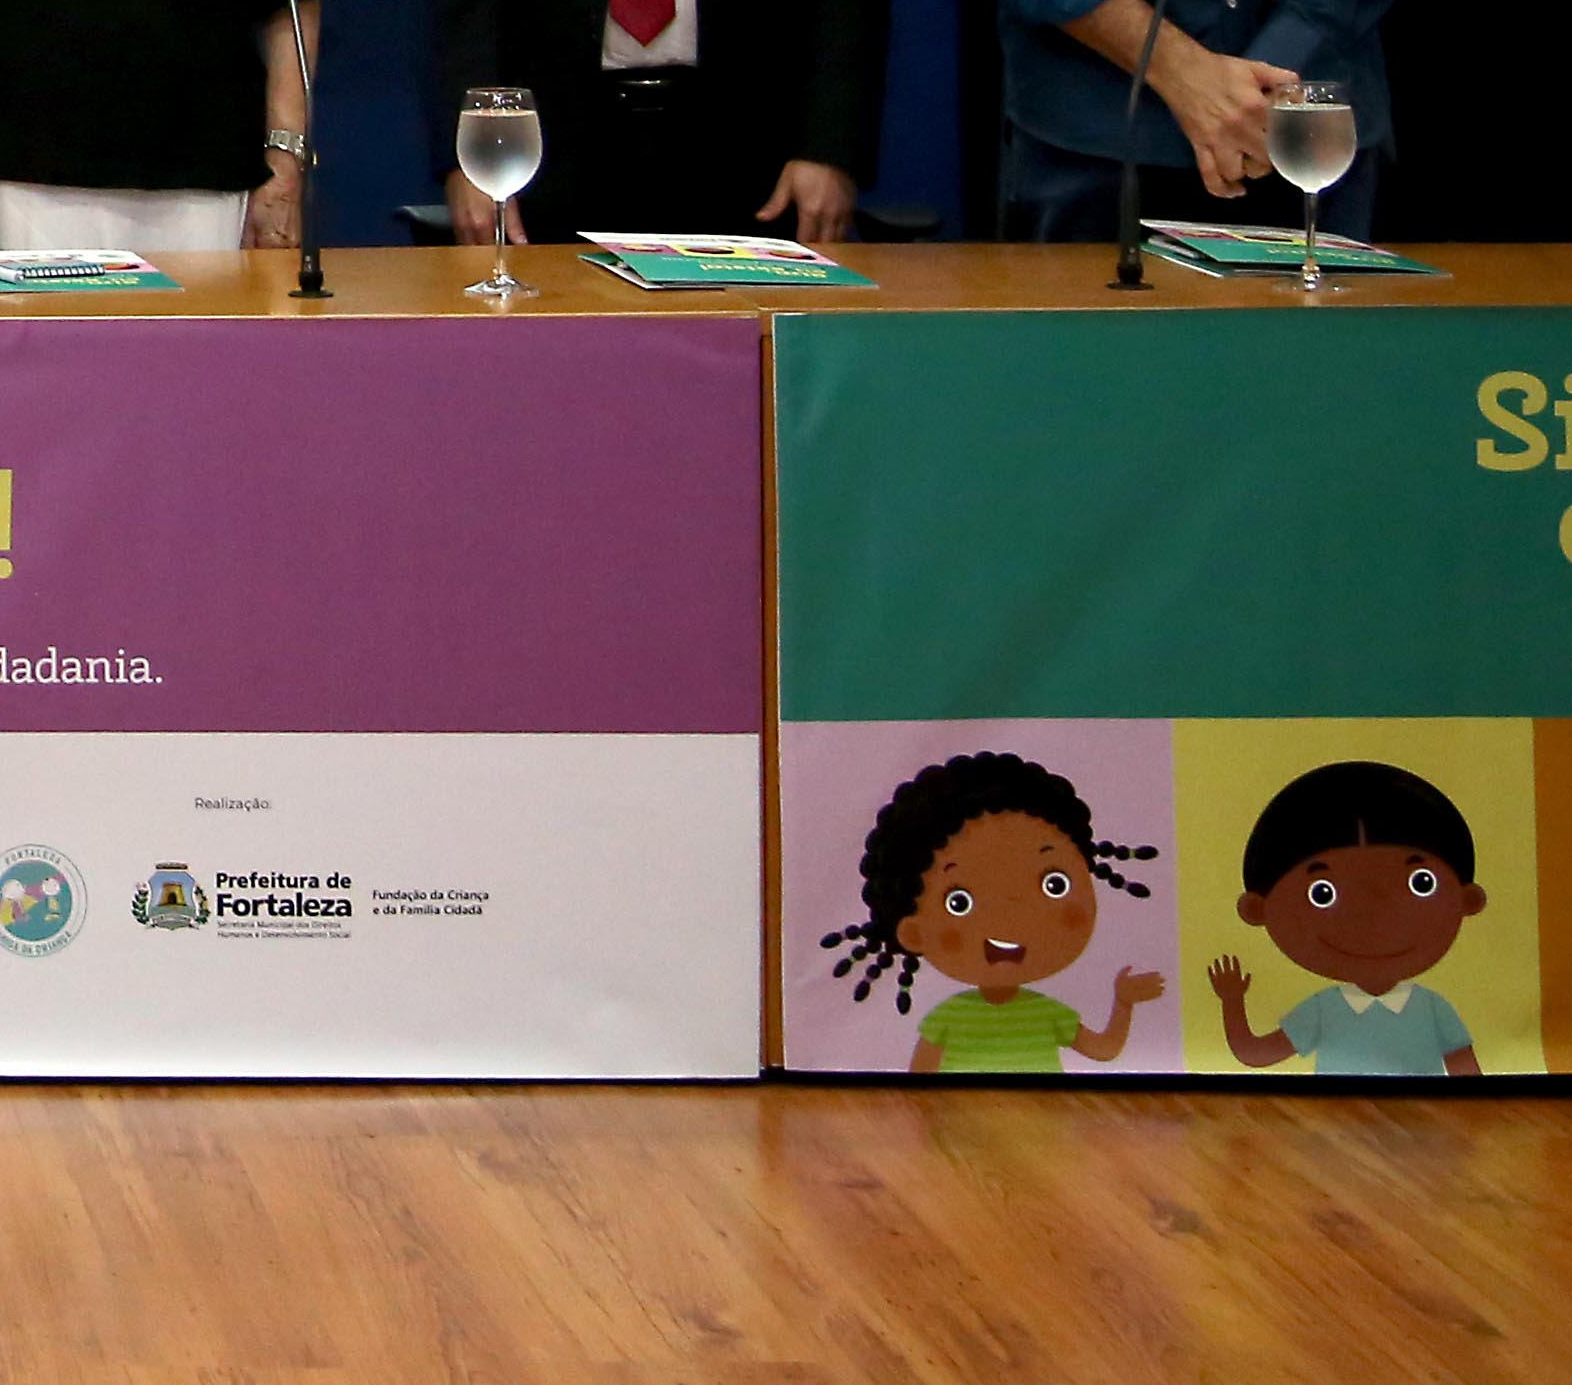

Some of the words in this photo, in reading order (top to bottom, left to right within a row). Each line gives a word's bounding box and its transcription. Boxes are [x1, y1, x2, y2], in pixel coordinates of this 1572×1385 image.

[195, 797, 272, 812] Realização:
[216, 871, 320, 889] Prefeitura
[326, 871, 352, 889] de
[372, 889, 427, 902] Fundação
[430, 889, 444, 900] da
[447, 889, 489, 902] Criança
[216, 892, 352, 917] Fortaleza
[372, 907, 380, 915] e
[382, 905, 397, 915] da
